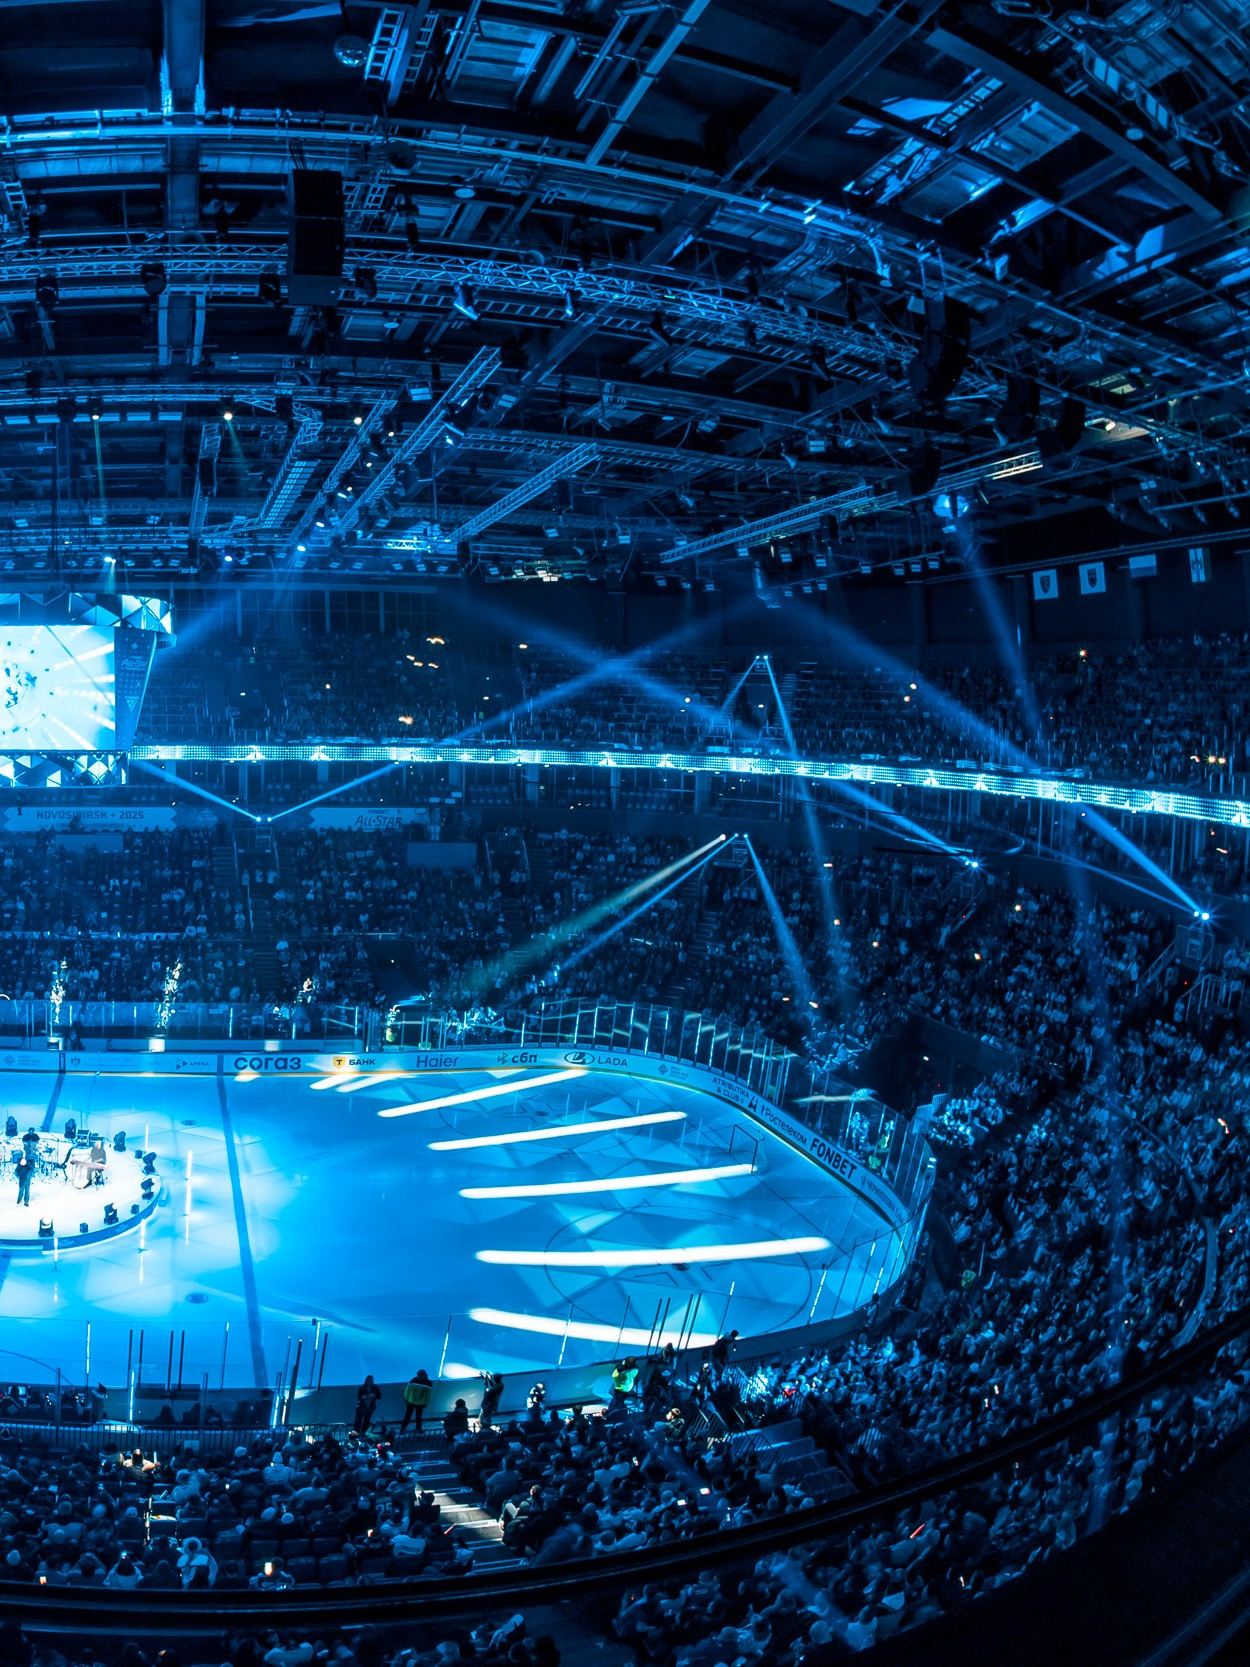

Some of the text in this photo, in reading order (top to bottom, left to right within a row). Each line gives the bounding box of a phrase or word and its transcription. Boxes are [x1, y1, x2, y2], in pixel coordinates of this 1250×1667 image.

[119, 810, 144, 820] 2025
[349, 1058, 376, 1066] БАНК
[416, 1055, 458, 1068] Haier
[598, 1057, 628, 1068] LADA
[712, 1077, 750, 1099] ATRIBUTIKA
[765, 1108, 807, 1146] Ростелеком
[810, 1137, 858, 1179] FONBET
